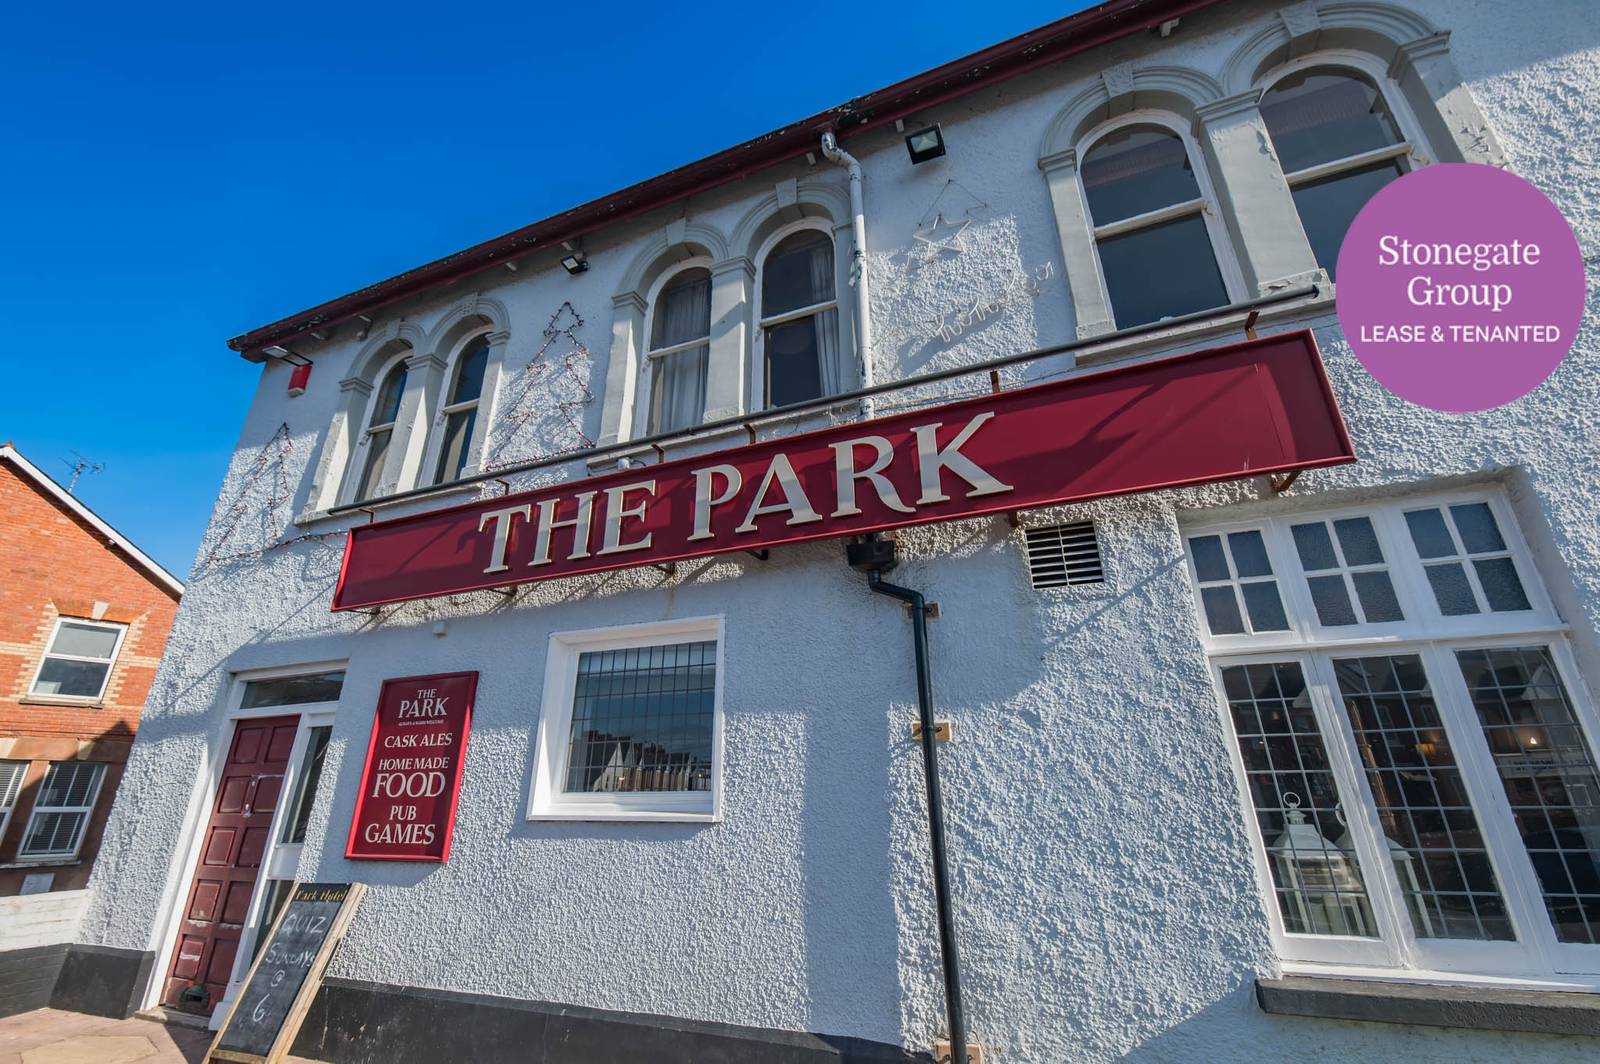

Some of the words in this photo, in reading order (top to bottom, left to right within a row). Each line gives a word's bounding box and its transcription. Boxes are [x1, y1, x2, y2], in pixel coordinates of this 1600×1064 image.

[478, 479, 657, 574] THE
[686, 411, 1014, 542] PARK
[417, 688, 437, 699] THE
[398, 697, 449, 719] PARK
[384, 734, 418, 748] CASK
[419, 732, 453, 747] ALES
[378, 758, 414, 771] HOME
[414, 757, 450, 769] MADE
[372, 772, 446, 798] FOOD
[389, 805, 417, 821] PUB
[364, 823, 436, 845] GAMES
[282, 913, 327, 936] QUIZ
